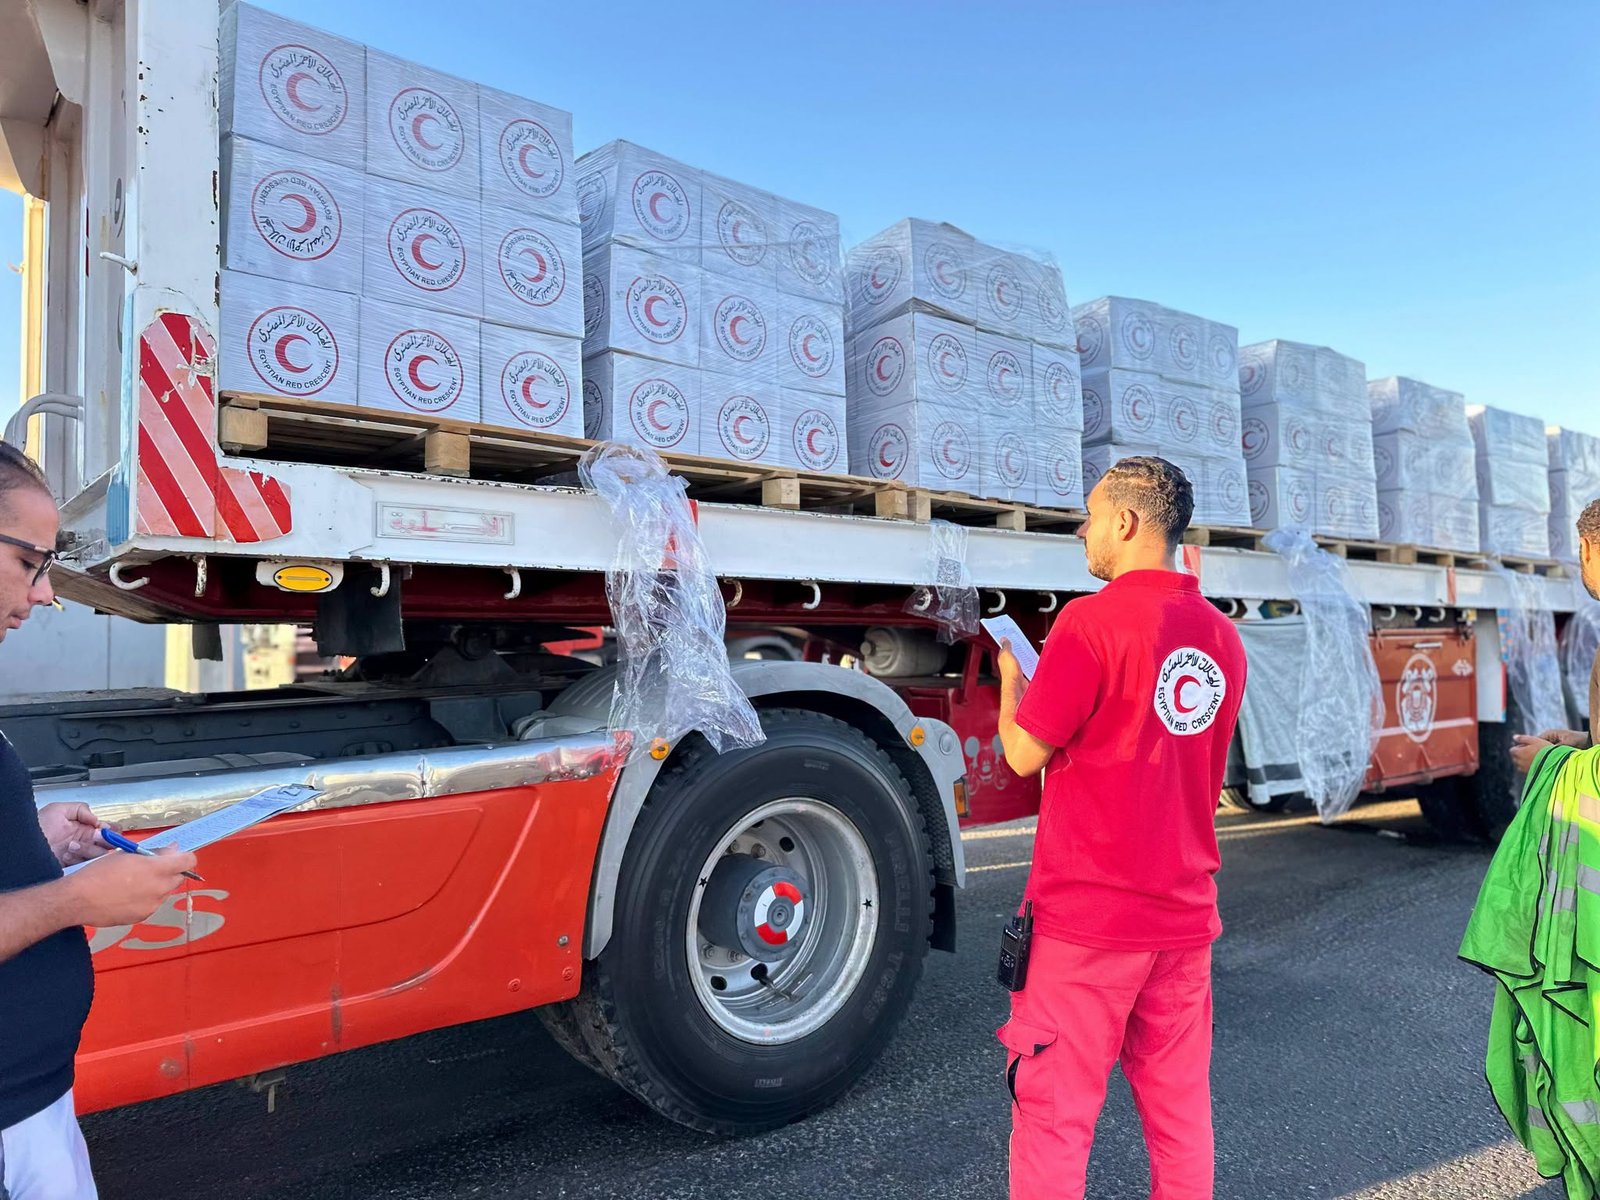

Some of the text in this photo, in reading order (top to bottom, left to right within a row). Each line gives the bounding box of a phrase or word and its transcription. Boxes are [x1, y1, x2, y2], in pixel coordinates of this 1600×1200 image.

[271, 83, 342, 130] EGYPTIAN RED CRESCENT
[399, 126, 460, 167] EGYPTIAN RED CRESCENT
[507, 157, 528, 189] EGYPTIAN
[541, 168, 560, 193] CRESCENT
[258, 177, 333, 220] EGYPTIAN RED CRESCENT
[504, 235, 526, 259] CRESCENT
[538, 240, 559, 271] EGYPTIAN
[397, 247, 460, 286] EGYPTIAN RED CRESCENT
[633, 306, 651, 334] EGYPTIAN
[663, 317, 682, 339] CRESCENT
[259, 349, 333, 389] EGYPTIAN RED CRESCENT
[394, 367, 458, 405] EGYPTIAN RED CRESCENT
[509, 389, 530, 420] EGYPTIAN
[545, 397, 566, 422] CRESCENT
[637, 412, 654, 439] EGYPTIAN
[667, 419, 685, 442] CRESCENT
[1198, 657, 1220, 688] الهلال
[1158, 686, 1221, 732] EGYPTIAN RED CRESCENT
